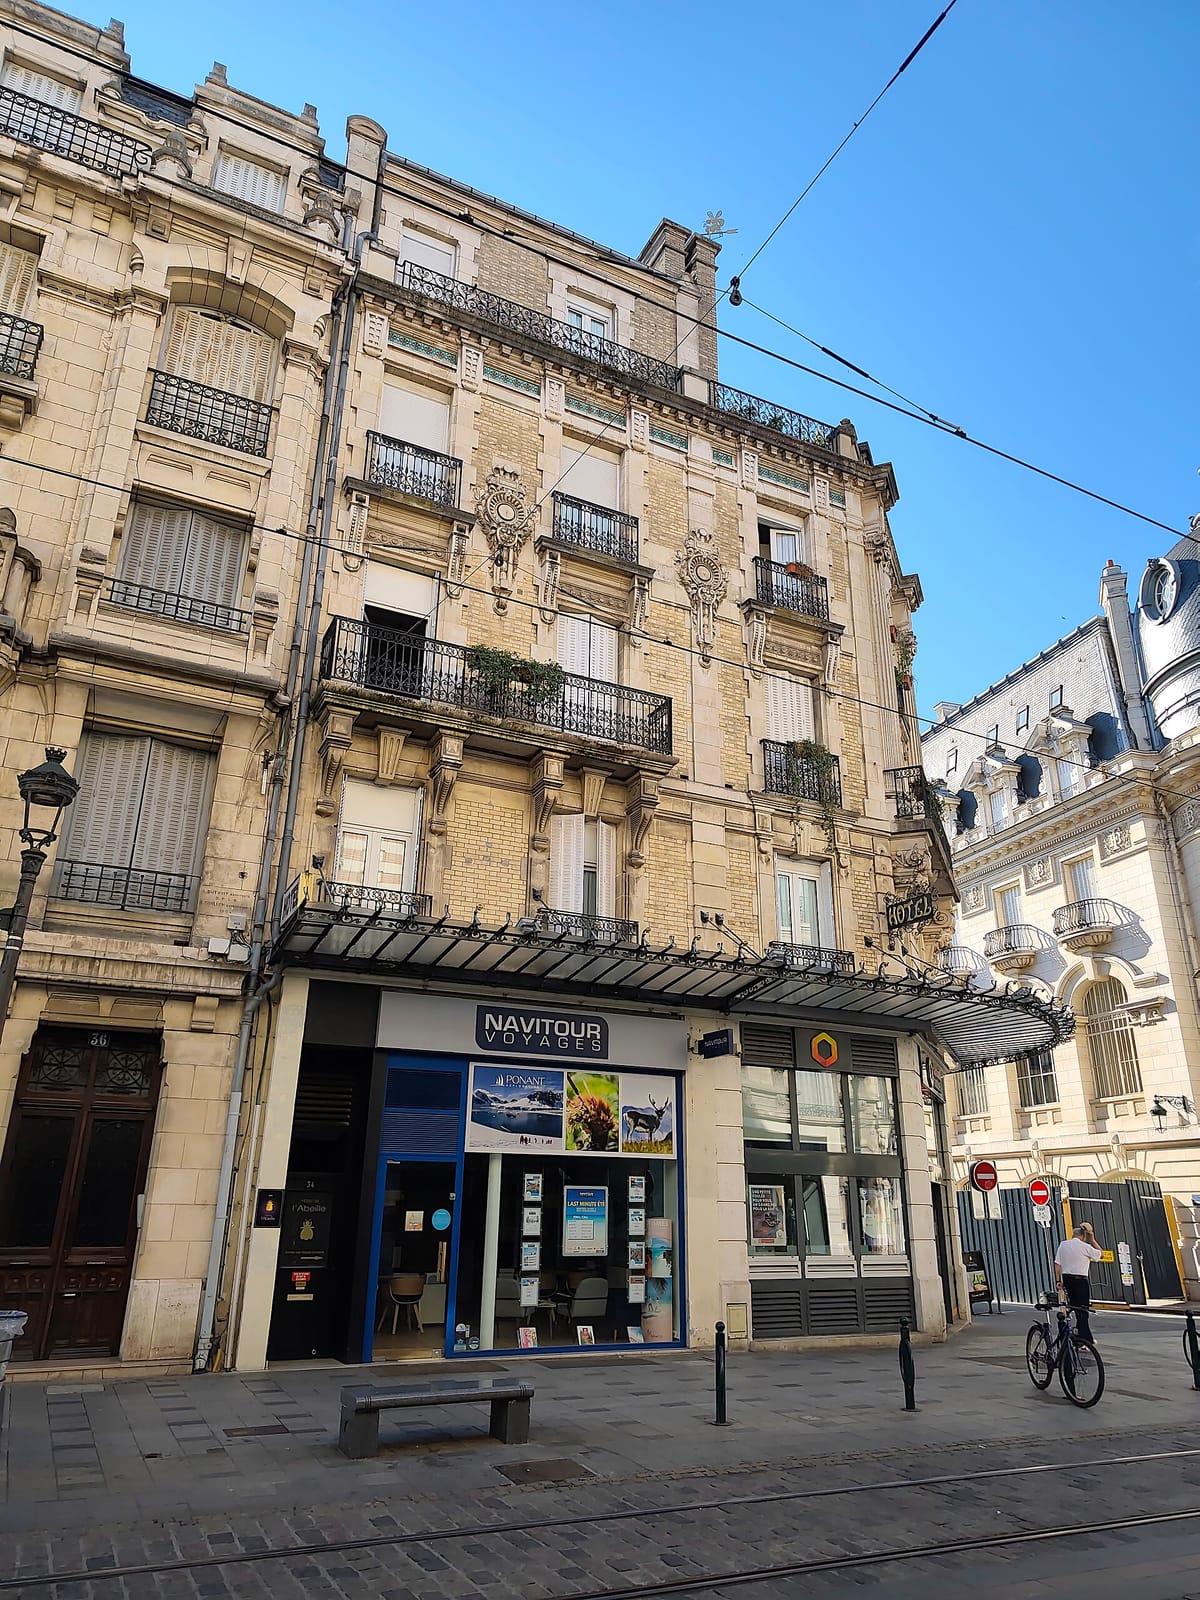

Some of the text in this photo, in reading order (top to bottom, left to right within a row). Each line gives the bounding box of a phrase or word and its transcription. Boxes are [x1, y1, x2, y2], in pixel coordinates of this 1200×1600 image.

[889, 896, 931, 926] HOTEL
[484, 1013, 601, 1039] NAVITOUR
[90, 1032, 107, 1046] 36
[485, 1031, 601, 1051] VOYAGES
[506, 1074, 545, 1087] PONANT
[291, 1204, 326, 1213] l'Abeille
